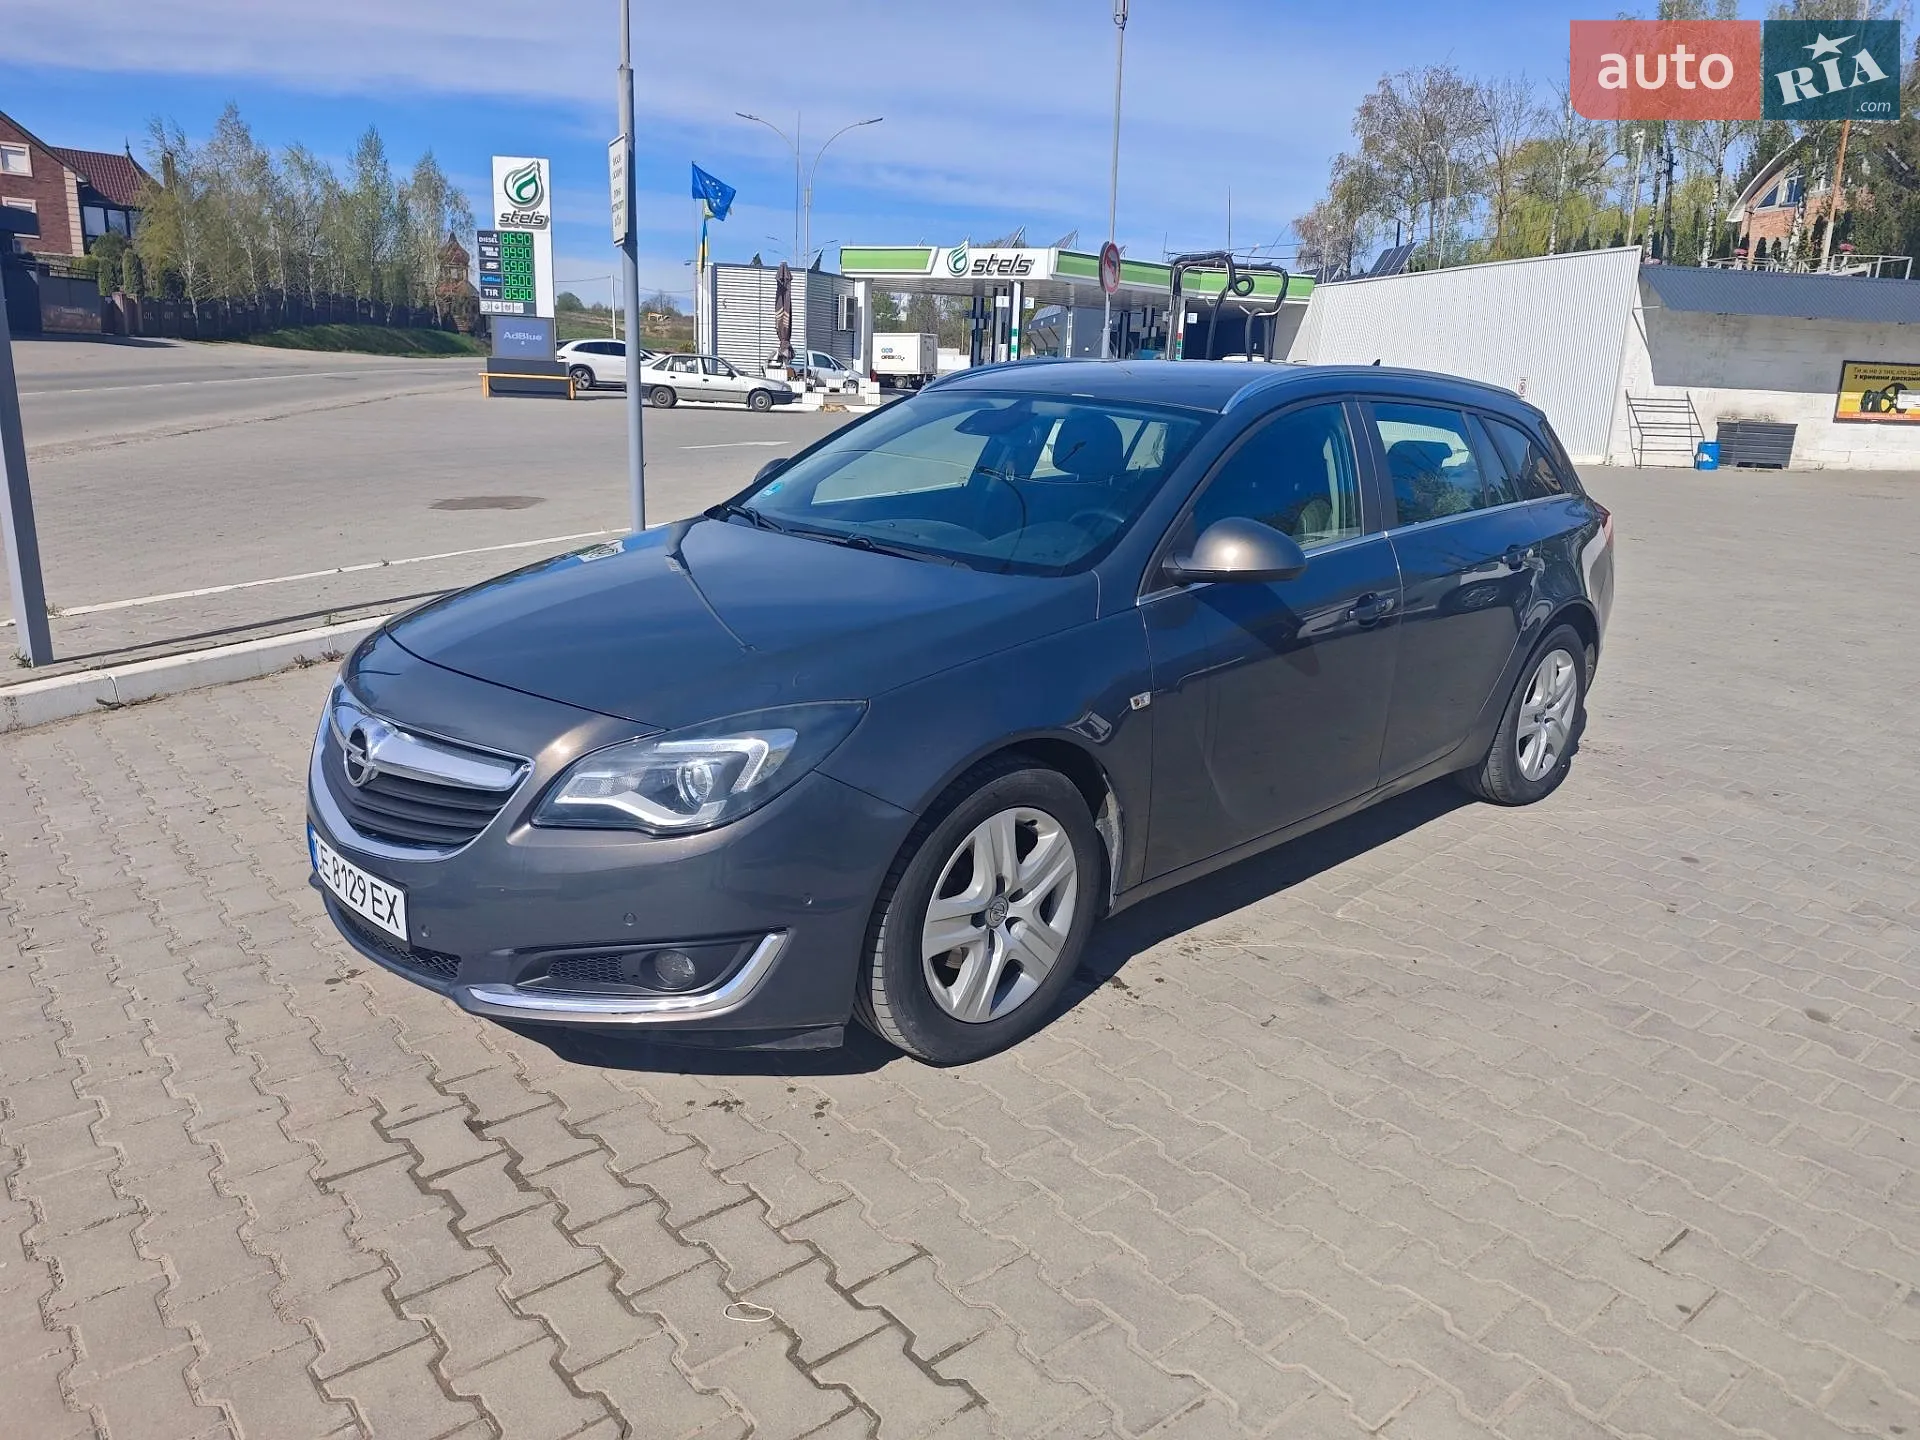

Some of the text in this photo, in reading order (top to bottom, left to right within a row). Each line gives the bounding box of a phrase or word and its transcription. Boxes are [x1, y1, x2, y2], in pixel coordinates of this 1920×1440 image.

[499, 210, 546, 227] stels
[478, 236, 499, 244] DIESEL
[971, 253, 1034, 275] stels
[484, 288, 500, 297] TIR
[503, 331, 543, 342] AdBlue
[316, 838, 400, 930] E 8129 EX
